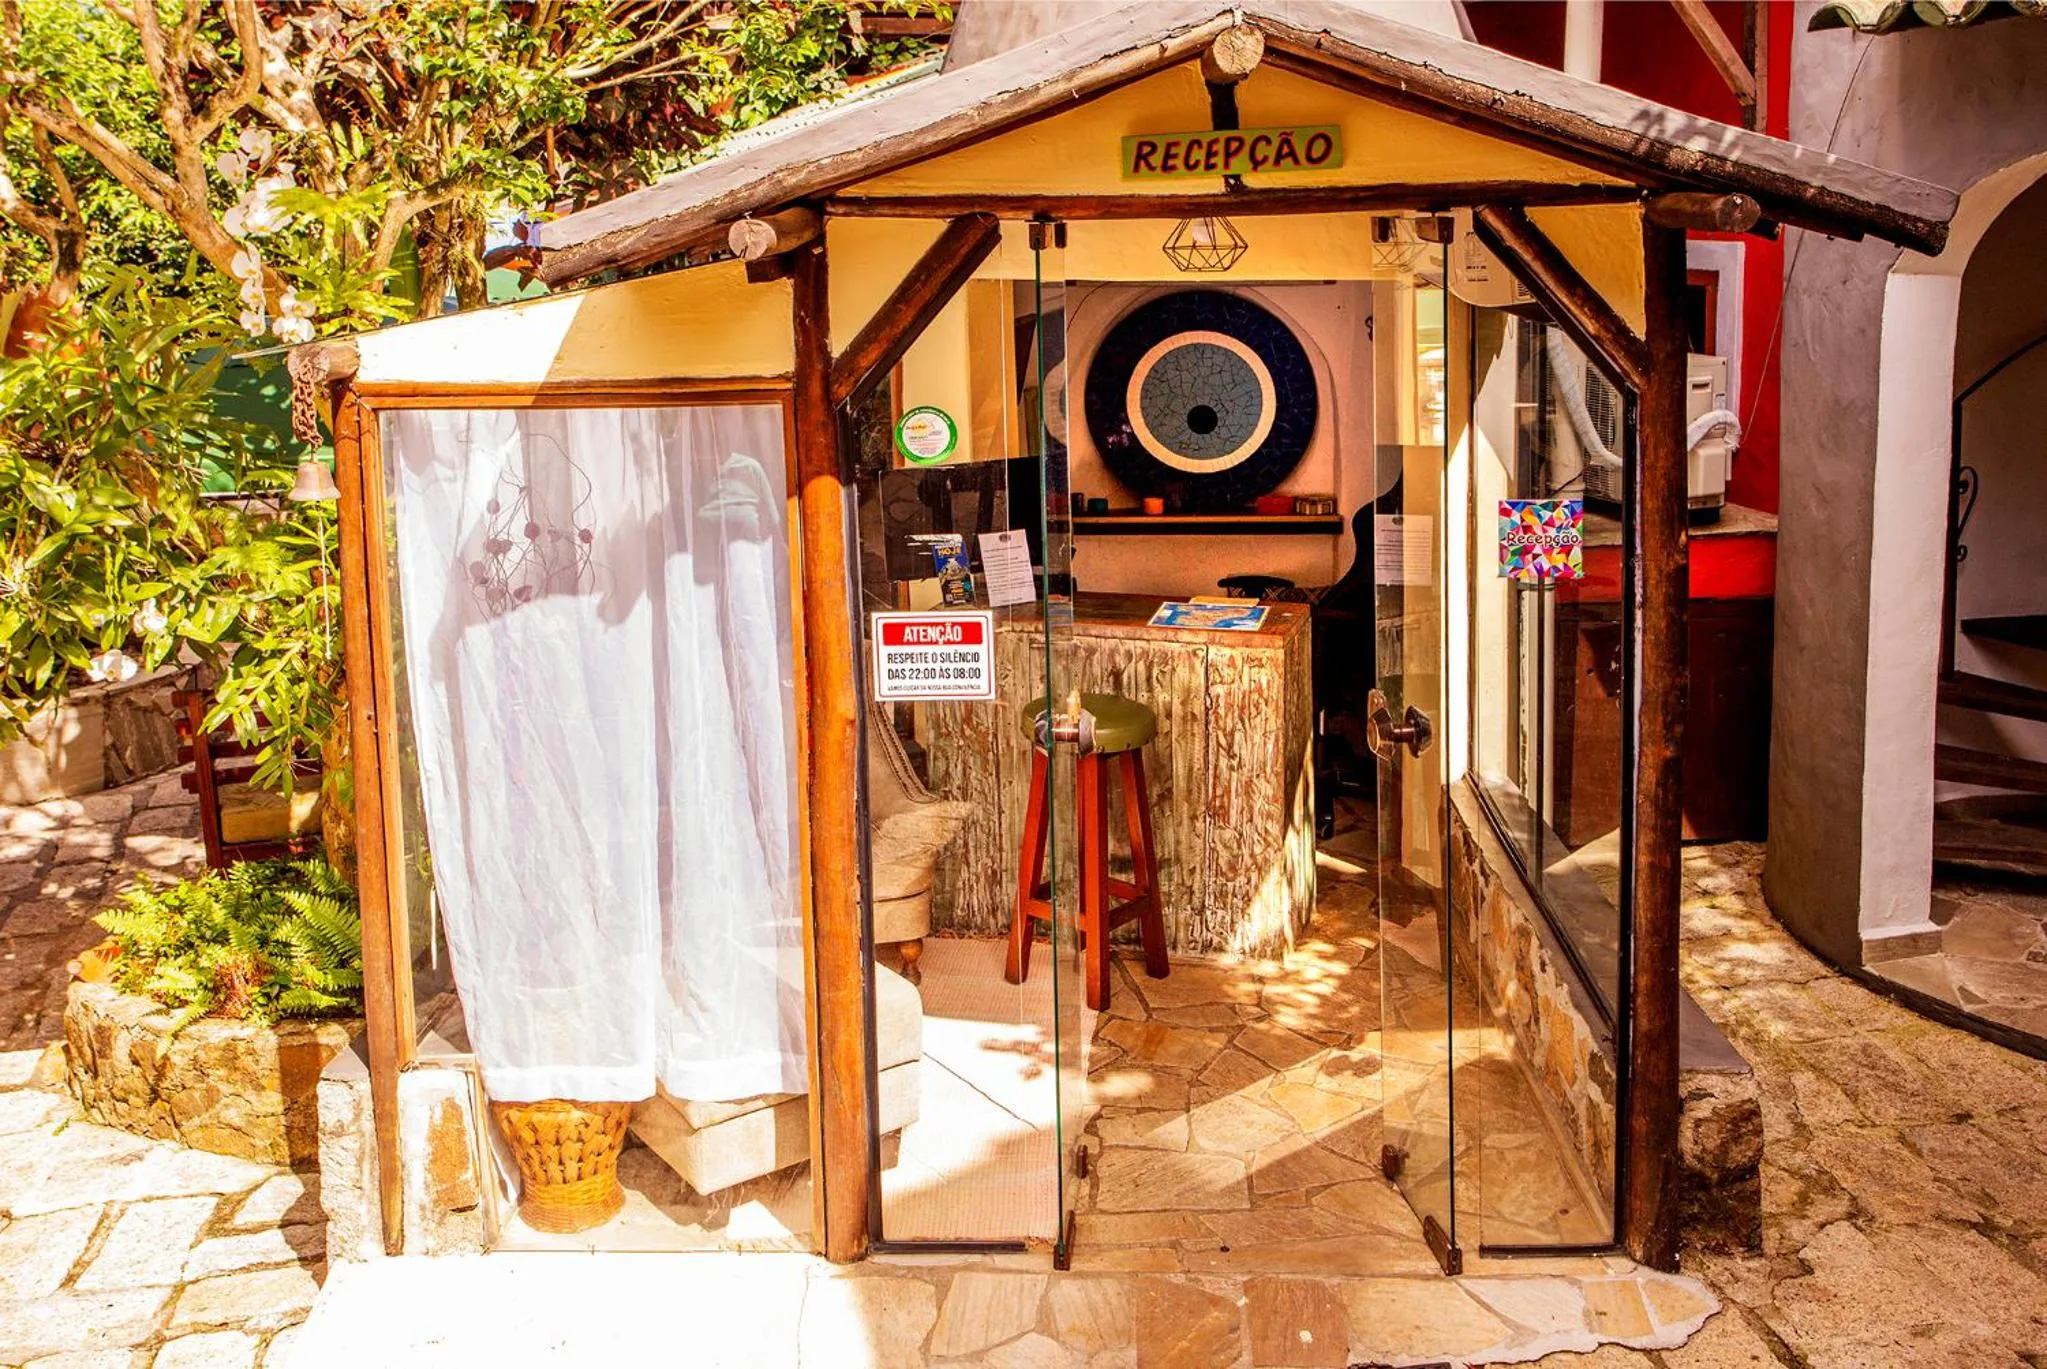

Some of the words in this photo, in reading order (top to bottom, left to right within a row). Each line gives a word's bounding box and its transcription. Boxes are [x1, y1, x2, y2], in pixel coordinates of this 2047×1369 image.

[1132, 131, 1334, 174] RECEPÇÃO
[1507, 531, 1579, 546] Recepção
[903, 621, 963, 645] ATENÇÃO
[887, 652, 929, 664] RESPEITE
[931, 652, 938, 663] O
[940, 650, 980, 663] SILÊNCIO
[887, 668, 906, 680] DAS
[908, 668, 937, 679] 22:00
[939, 666, 951, 679] ÀS
[953, 667, 981, 679] 08:00
